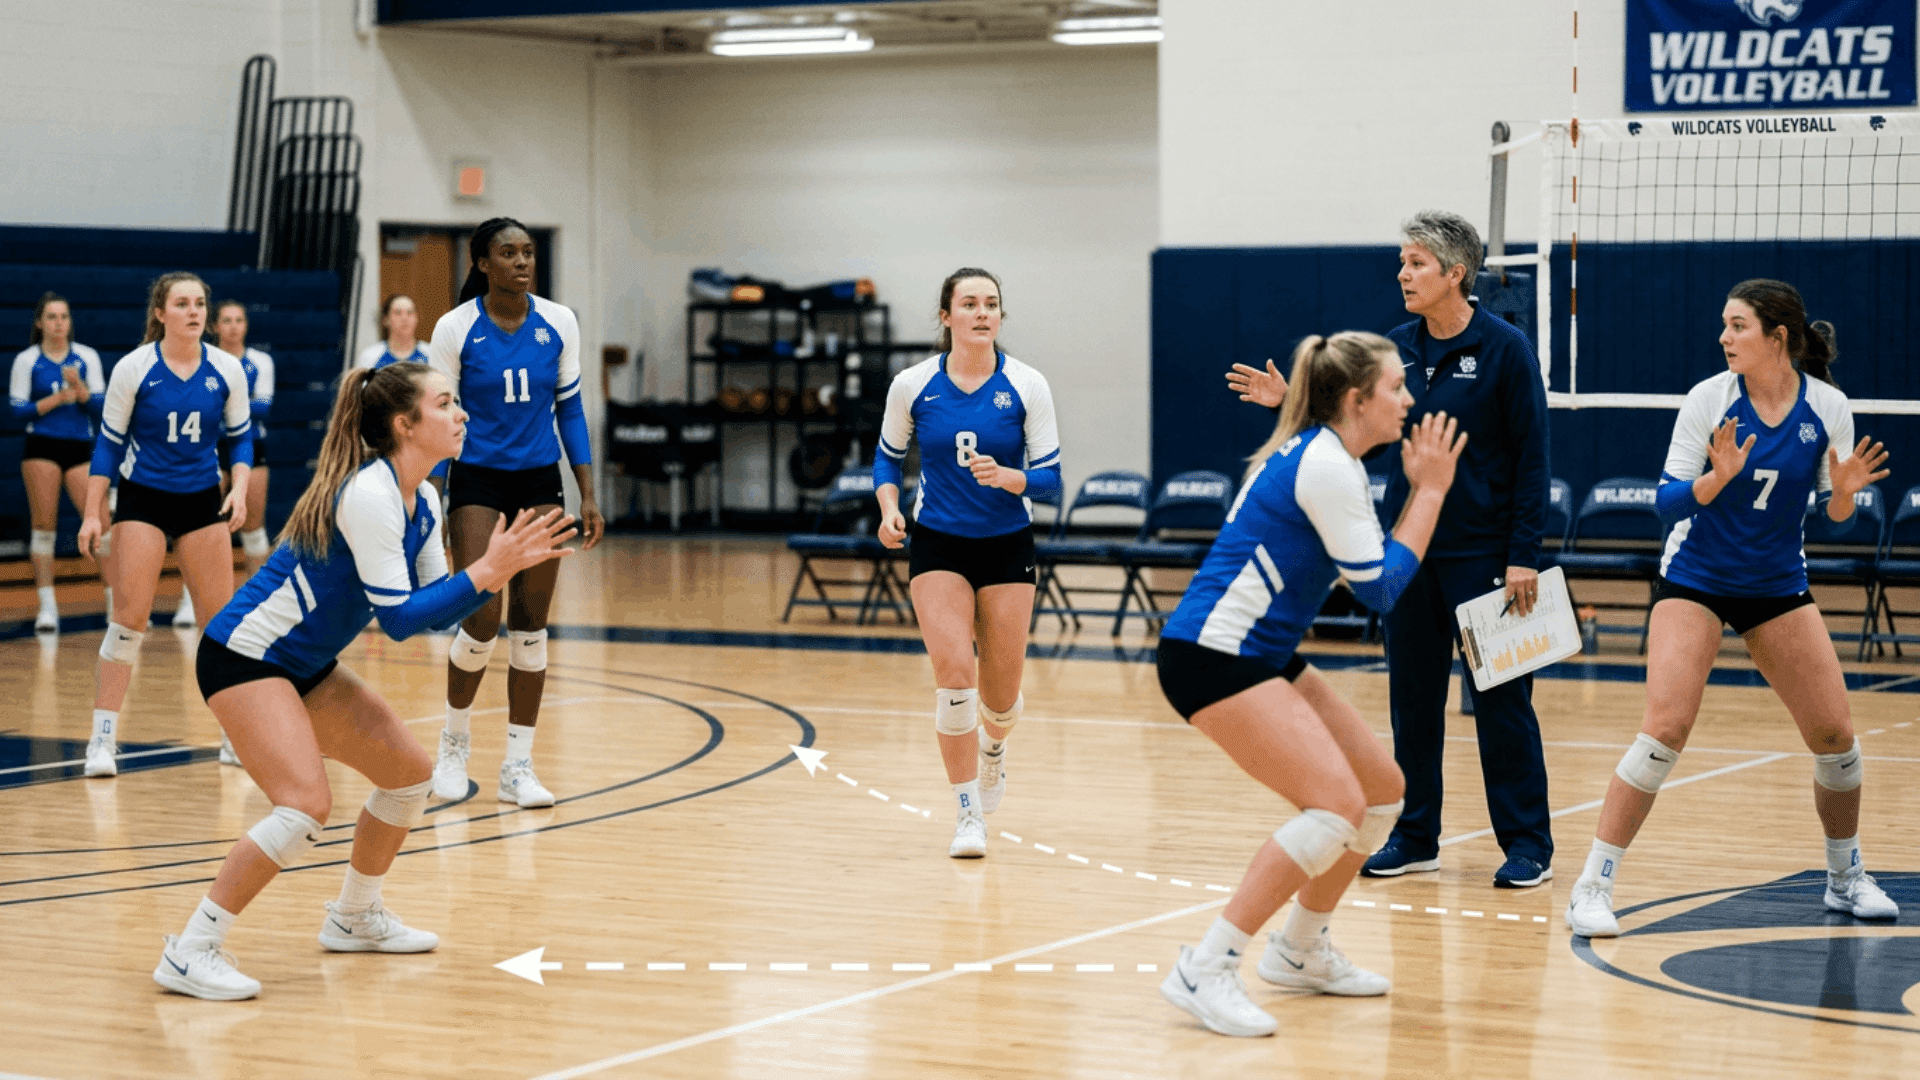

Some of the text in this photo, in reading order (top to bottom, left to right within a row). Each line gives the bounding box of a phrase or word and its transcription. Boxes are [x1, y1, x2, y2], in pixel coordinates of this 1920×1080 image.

[1649, 26, 1894, 70] WILDCATS
[1651, 68, 1892, 104] VOLLEYBALL
[1672, 117, 1837, 136] WILDCATS VOLLEYBALL
[503, 368, 531, 403] 11
[167, 411, 202, 443] 14
[955, 430, 978, 467] 8
[1753, 468, 1779, 510] 7
